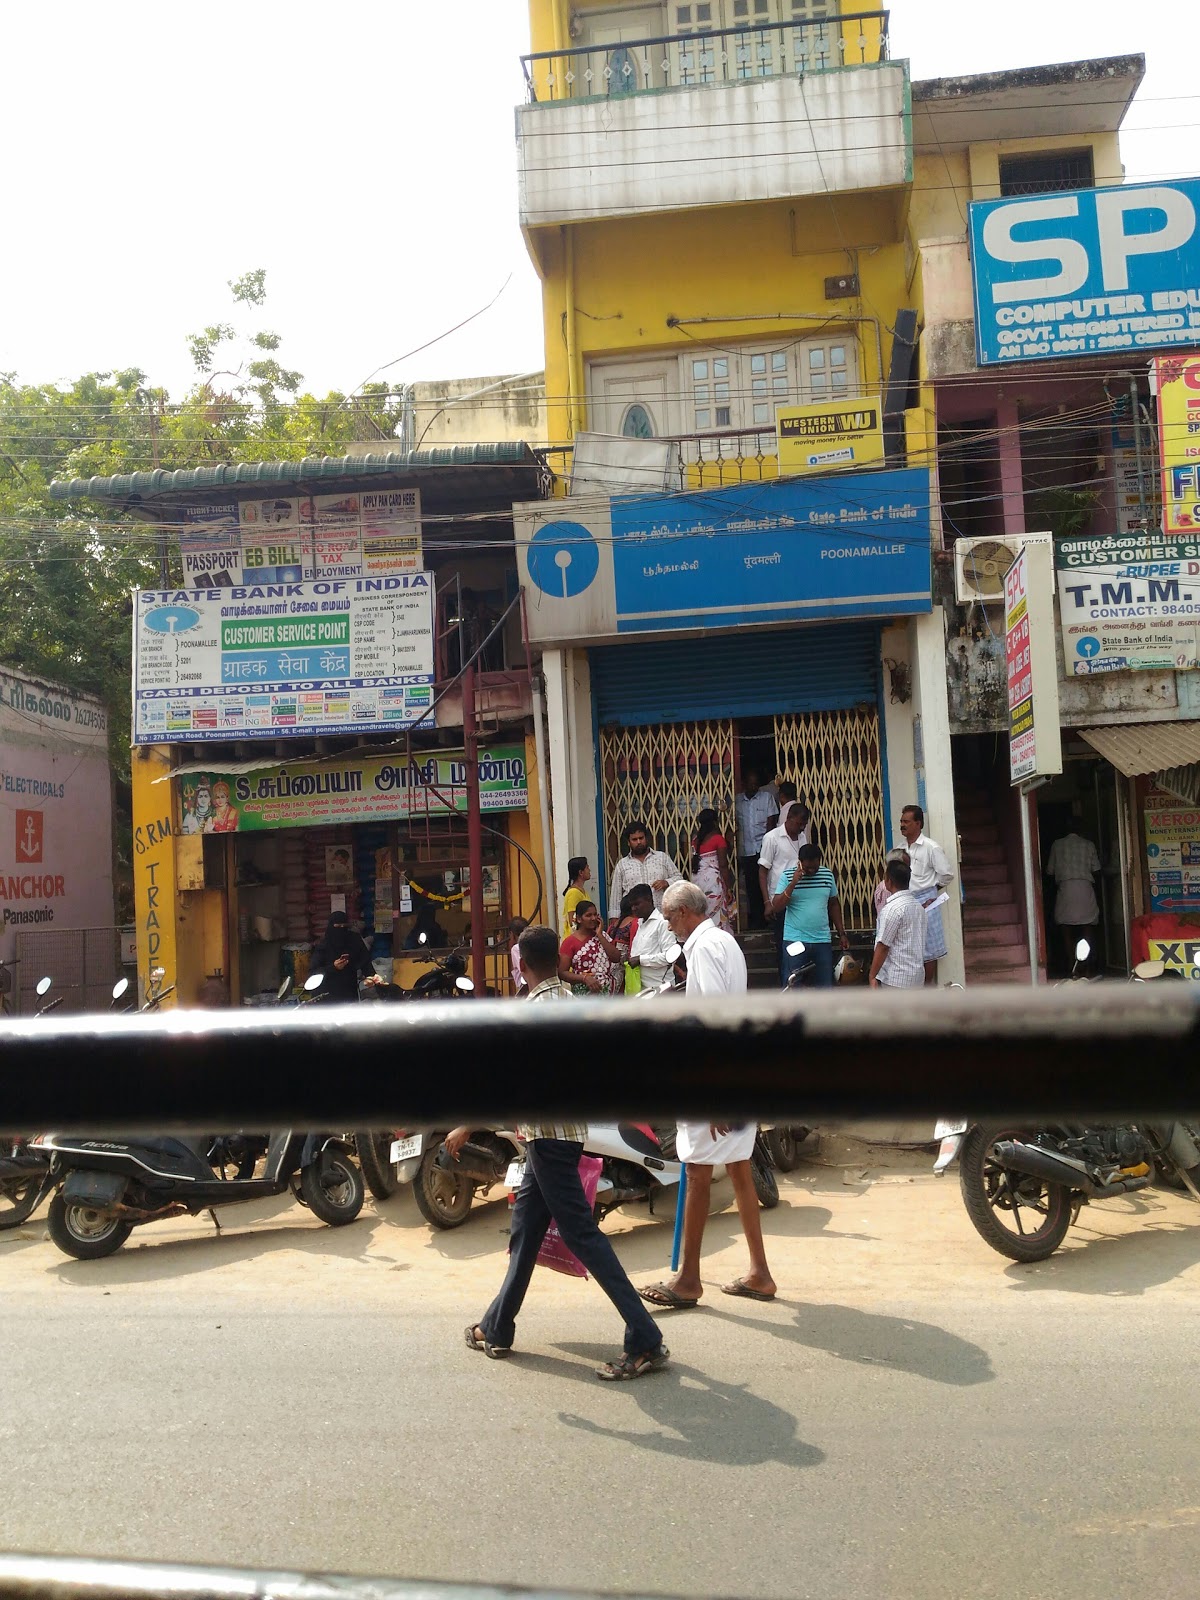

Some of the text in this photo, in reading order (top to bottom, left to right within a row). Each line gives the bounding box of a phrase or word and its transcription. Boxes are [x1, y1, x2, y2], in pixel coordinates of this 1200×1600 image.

[983, 187, 1196, 303] SP
[995, 295, 1146, 326] COMPUTER
[997, 314, 1185, 345] GOVT. REGISTERED
[998, 345, 1020, 358] AN
[783, 412, 871, 431] WESTERN WU
[800, 424, 836, 436] UNION
[793, 439, 816, 447] moving
[816, 437, 837, 445] money
[363, 492, 416, 508] APPLY PAN CARD HERE
[187, 507, 210, 515] FLIGHT
[808, 503, 918, 525] State Bank of India
[245, 545, 299, 567] EB BILL
[321, 554, 343, 564] TAX
[820, 544, 906, 560] POONAMALLEE
[1066, 547, 1180, 566] CUSTOMER
[186, 551, 239, 573] PASSPORT
[141, 575, 429, 604] STATE BANK OF INDIA
[353, 594, 380, 602] BUSINESS
[1090, 606, 1158, 621] CONTACT:
[224, 621, 347, 645] CUSTOMER SERVICE POINT
[1102, 635, 1122, 646] State
[1123, 635, 1143, 645] Bank
[1145, 634, 1153, 644] of
[1155, 633, 1173, 643] India
[180, 640, 217, 648] POONAMALLEE
[223, 651, 348, 679] ग्राहक सेवा केंद्र
[142, 675, 430, 699] CASH DEPOSIT TO ALL BANKS
[153, 733, 165, 741] 276
[166, 732, 185, 741] Trunk
[185, 731, 205, 740] Road,
[249, 728, 276, 737] Chennai
[5, 775, 65, 799] ELECTRICALS
[1149, 828, 1172, 837] MONEY
[0, 874, 65, 900] ANCHOR
[3, 905, 54, 925] Panasonic
[80, 1141, 130, 1150] Activa
